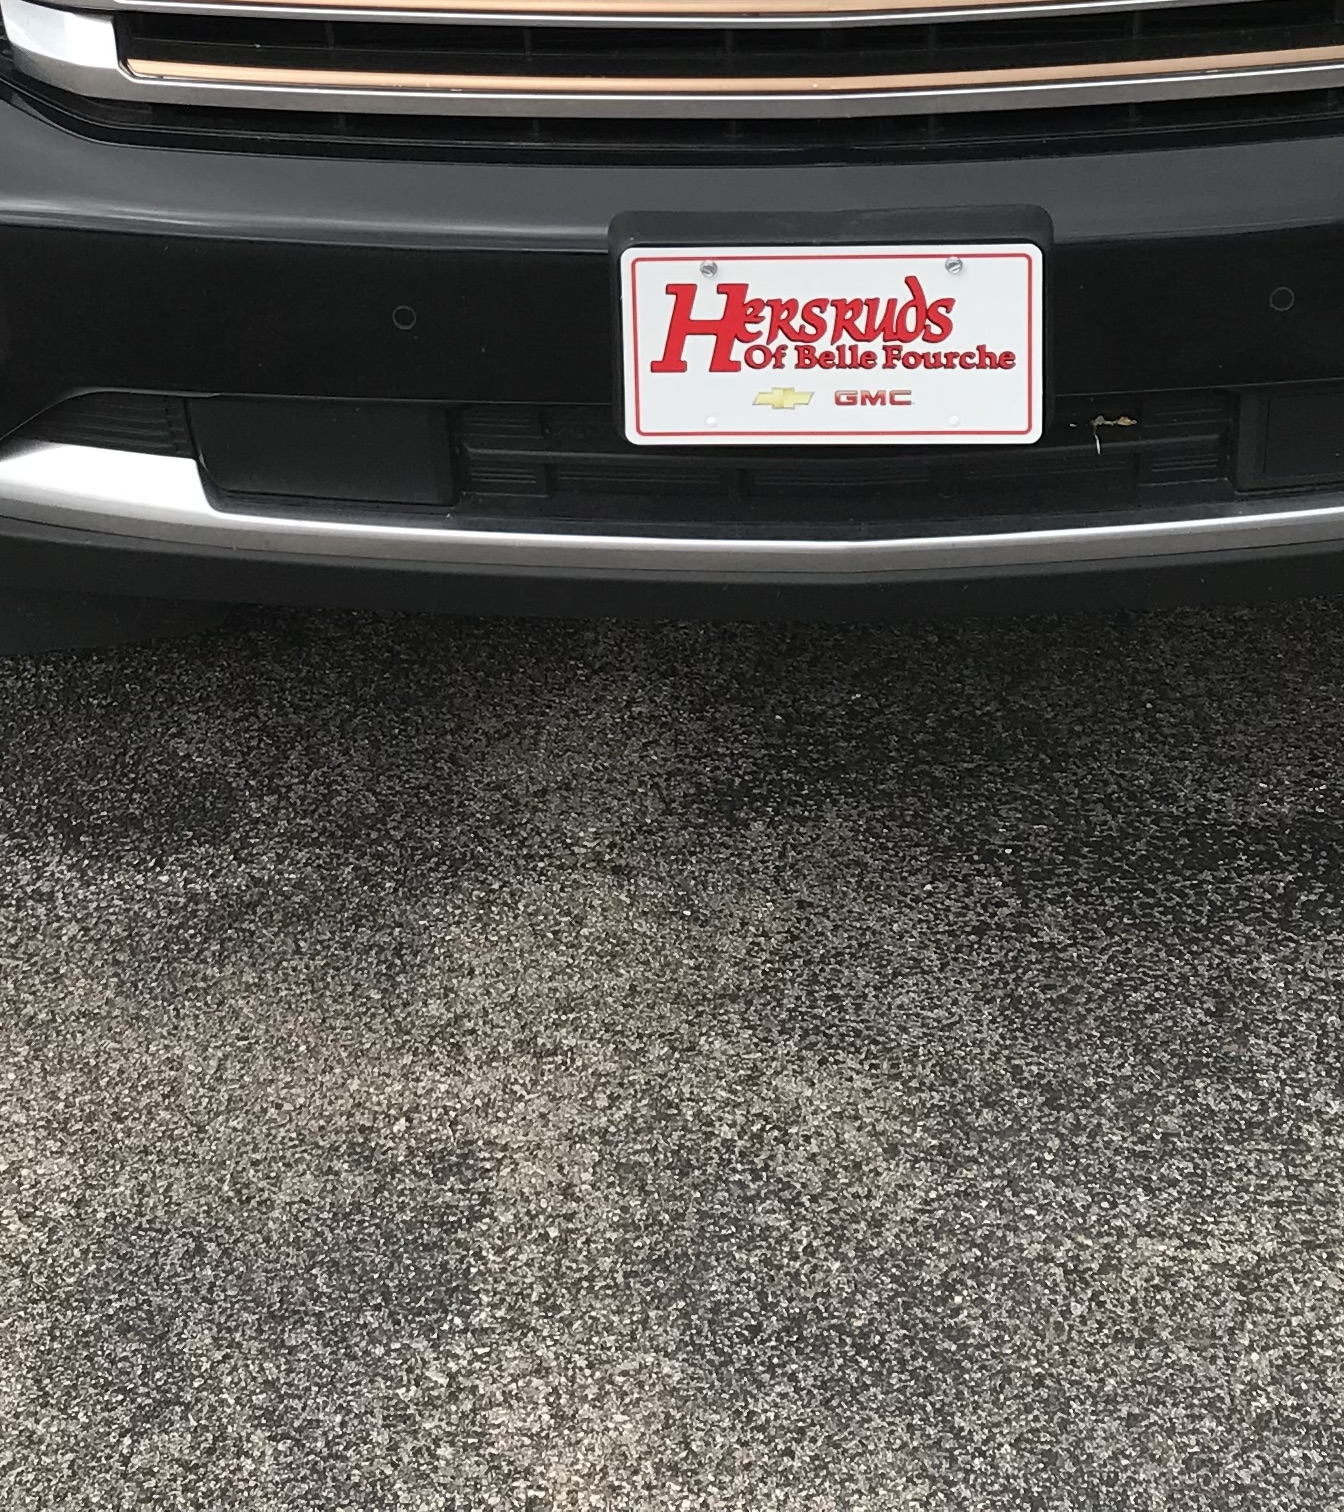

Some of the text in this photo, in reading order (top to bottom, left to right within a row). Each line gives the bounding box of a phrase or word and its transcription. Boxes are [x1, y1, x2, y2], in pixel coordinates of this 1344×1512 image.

[744, 343, 1017, 370] Of Belle Fourche
[834, 389, 913, 407] GMC
